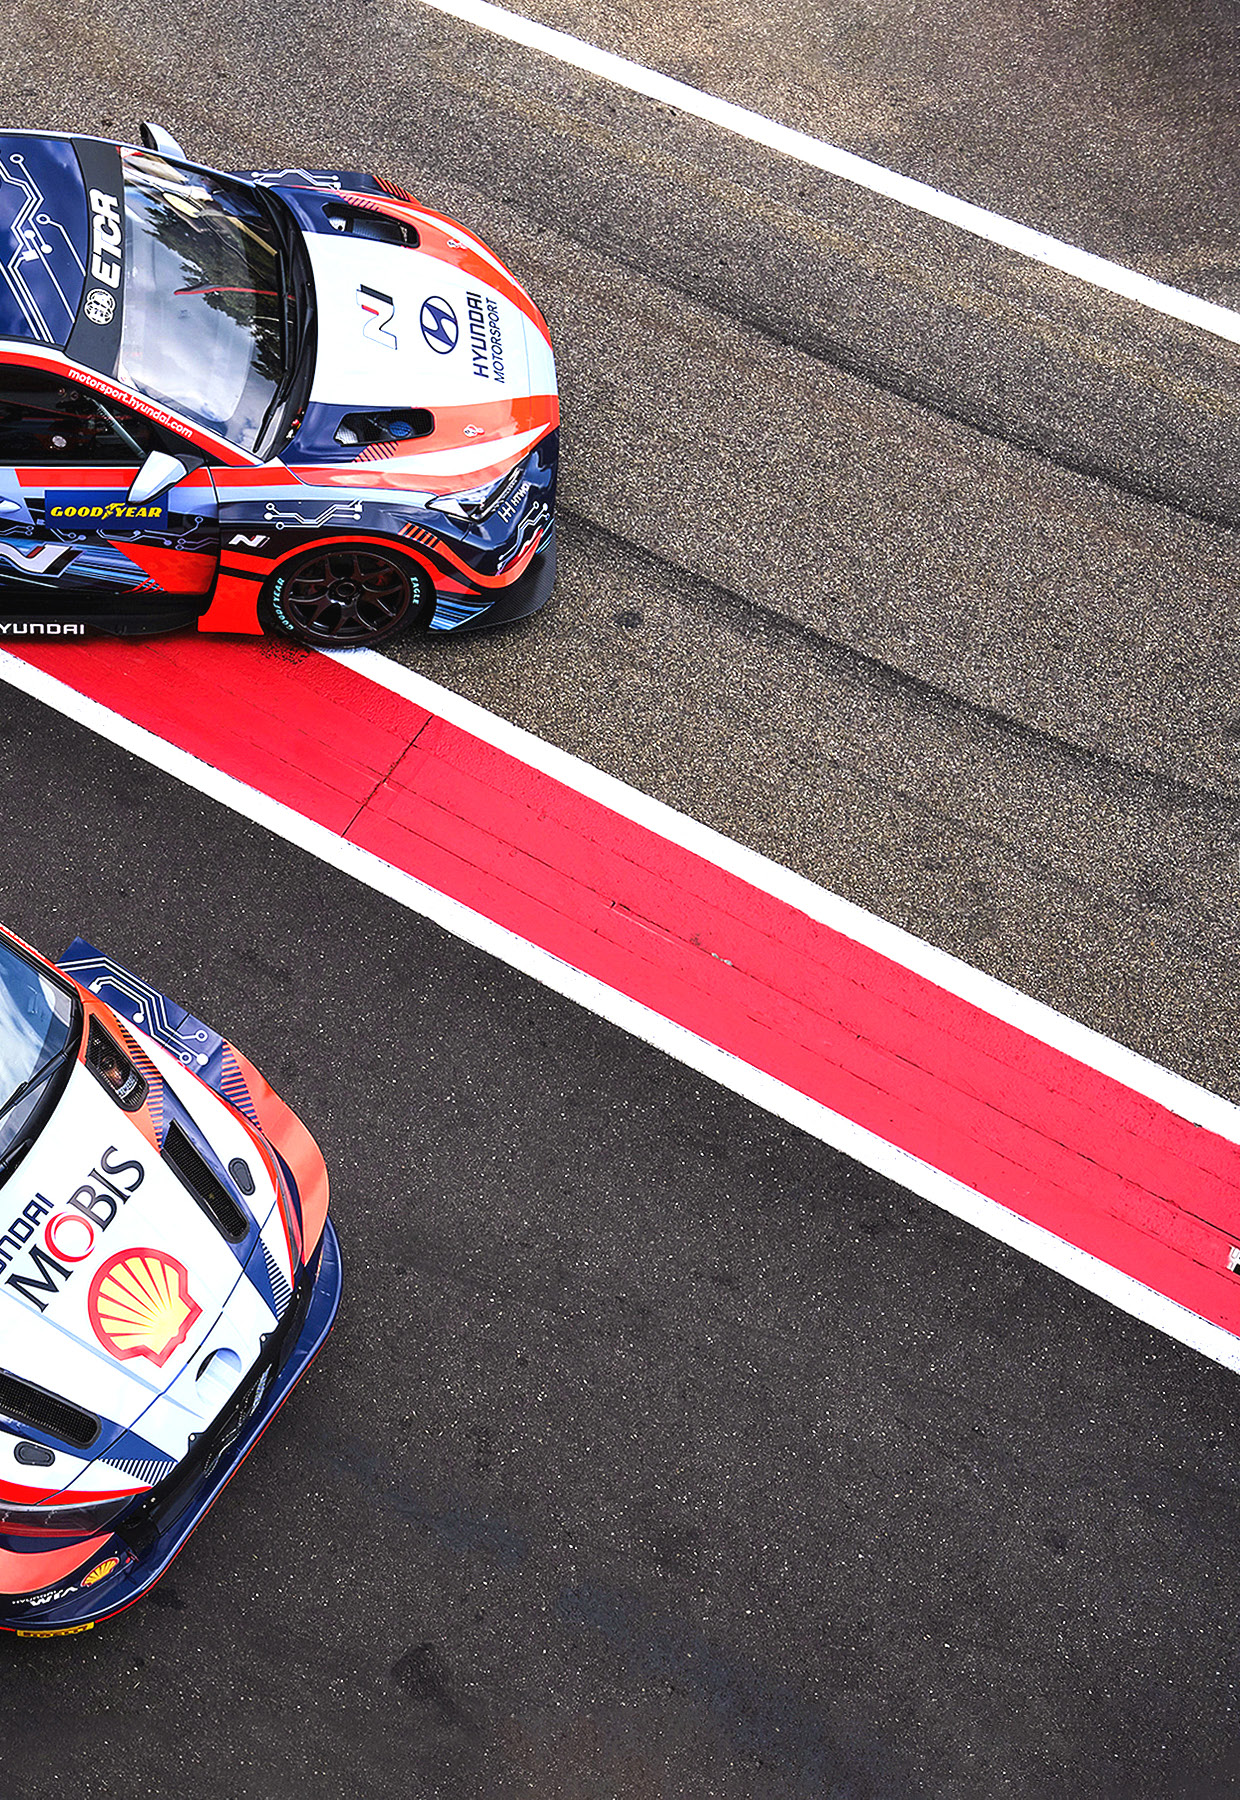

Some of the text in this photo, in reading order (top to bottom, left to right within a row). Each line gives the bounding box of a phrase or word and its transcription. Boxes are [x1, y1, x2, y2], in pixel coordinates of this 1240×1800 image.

[89, 188, 122, 289] ETCR
[466, 291, 490, 379] HYUNDAI
[486, 297, 505, 384] MOTORSPORT
[68, 369, 194, 438] motorsport.hyundai.com
[50, 502, 162, 520] GOODYEAR
[410, 576, 421, 605] EAGLE
[4, 1145, 145, 1313] MOBIS
